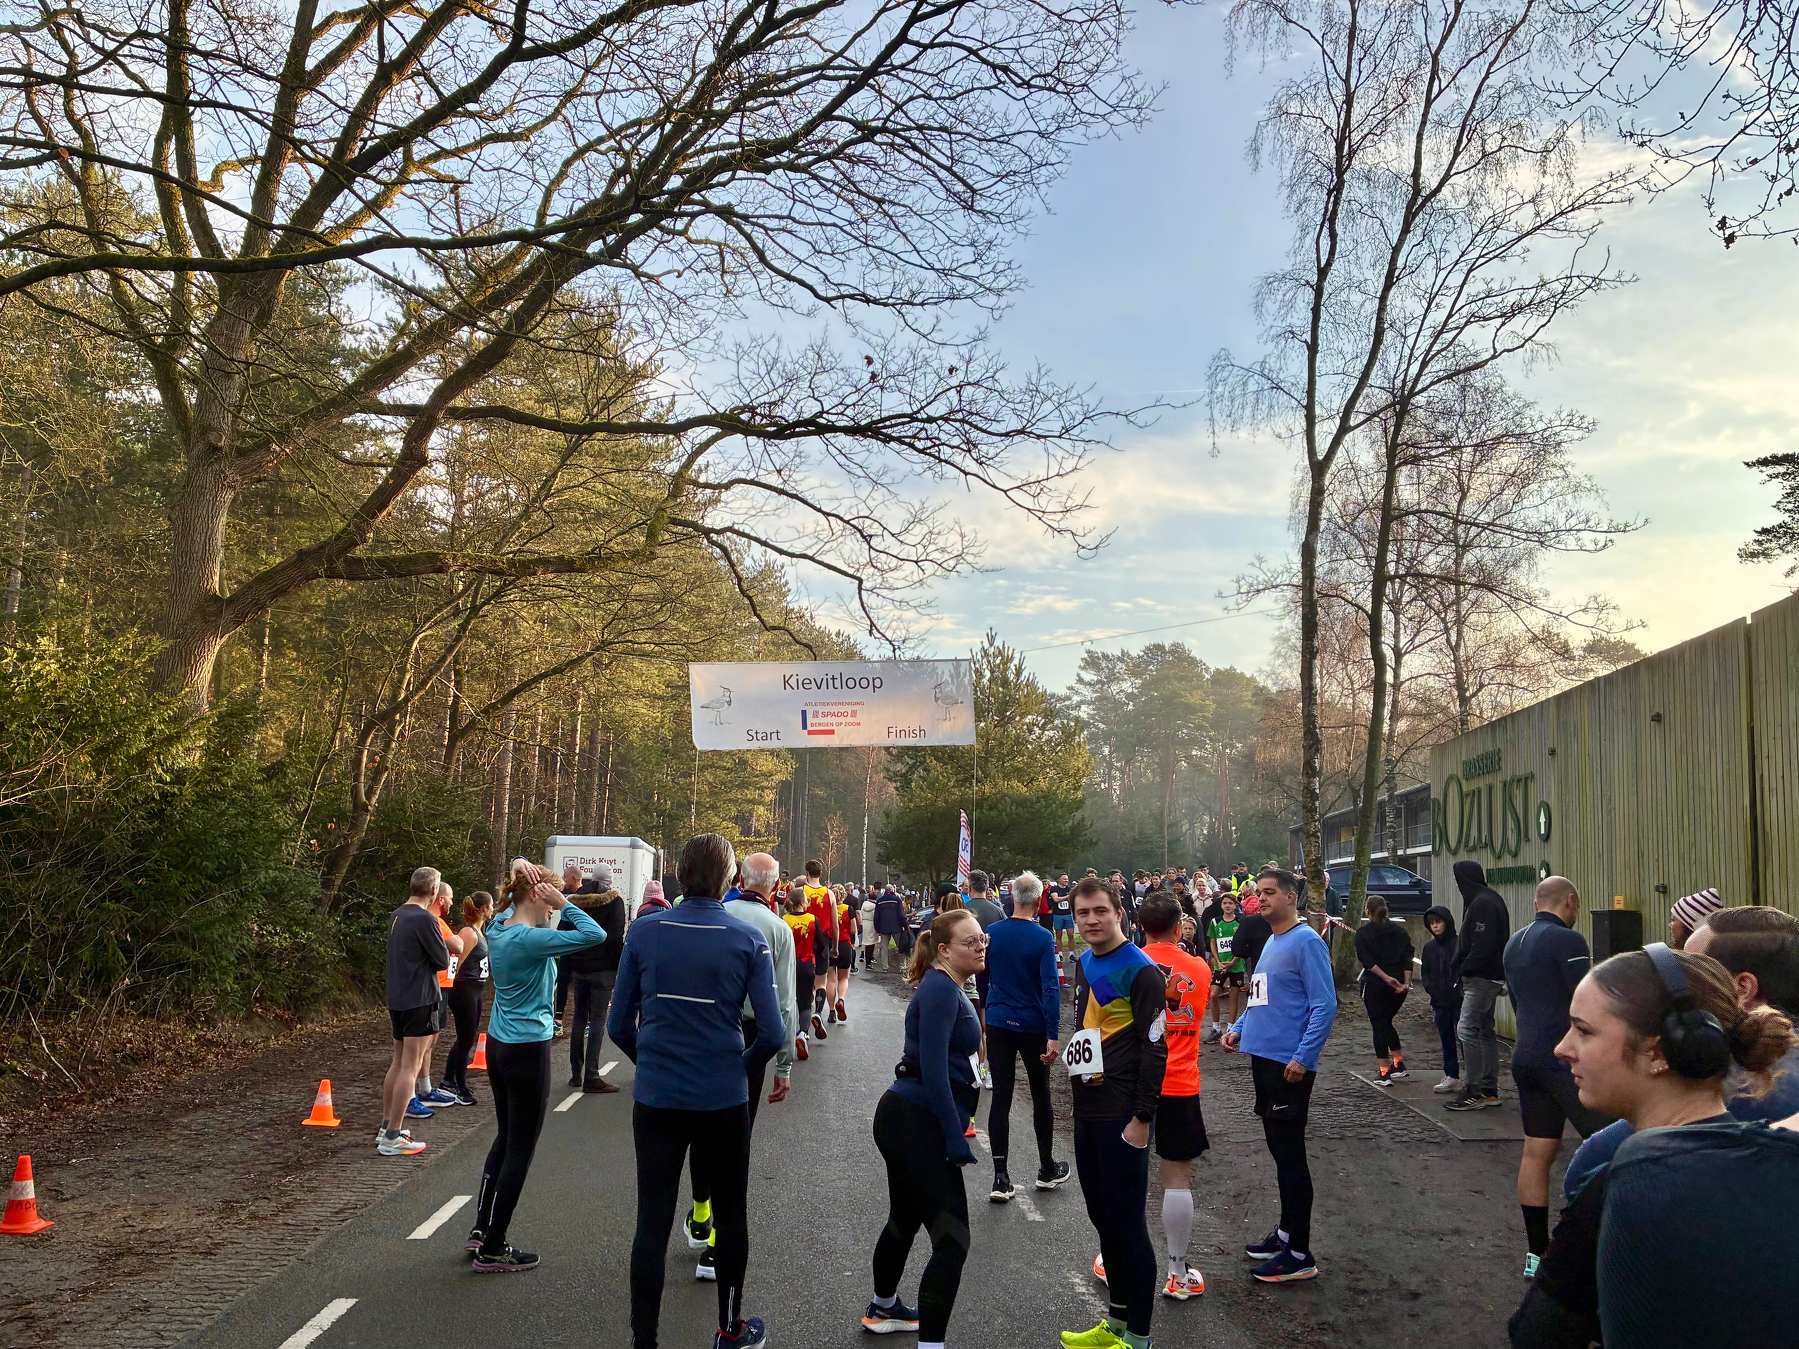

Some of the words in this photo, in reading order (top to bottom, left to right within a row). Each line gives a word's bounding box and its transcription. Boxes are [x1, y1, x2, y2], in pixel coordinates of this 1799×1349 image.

[782, 672, 884, 693] Kievitloop
[746, 729, 781, 741] Start
[887, 725, 926, 739] Finish
[1462, 748, 1502, 781] BRASSERIE
[579, 857, 597, 865] Dirk
[1066, 1038, 1093, 1066] 686
